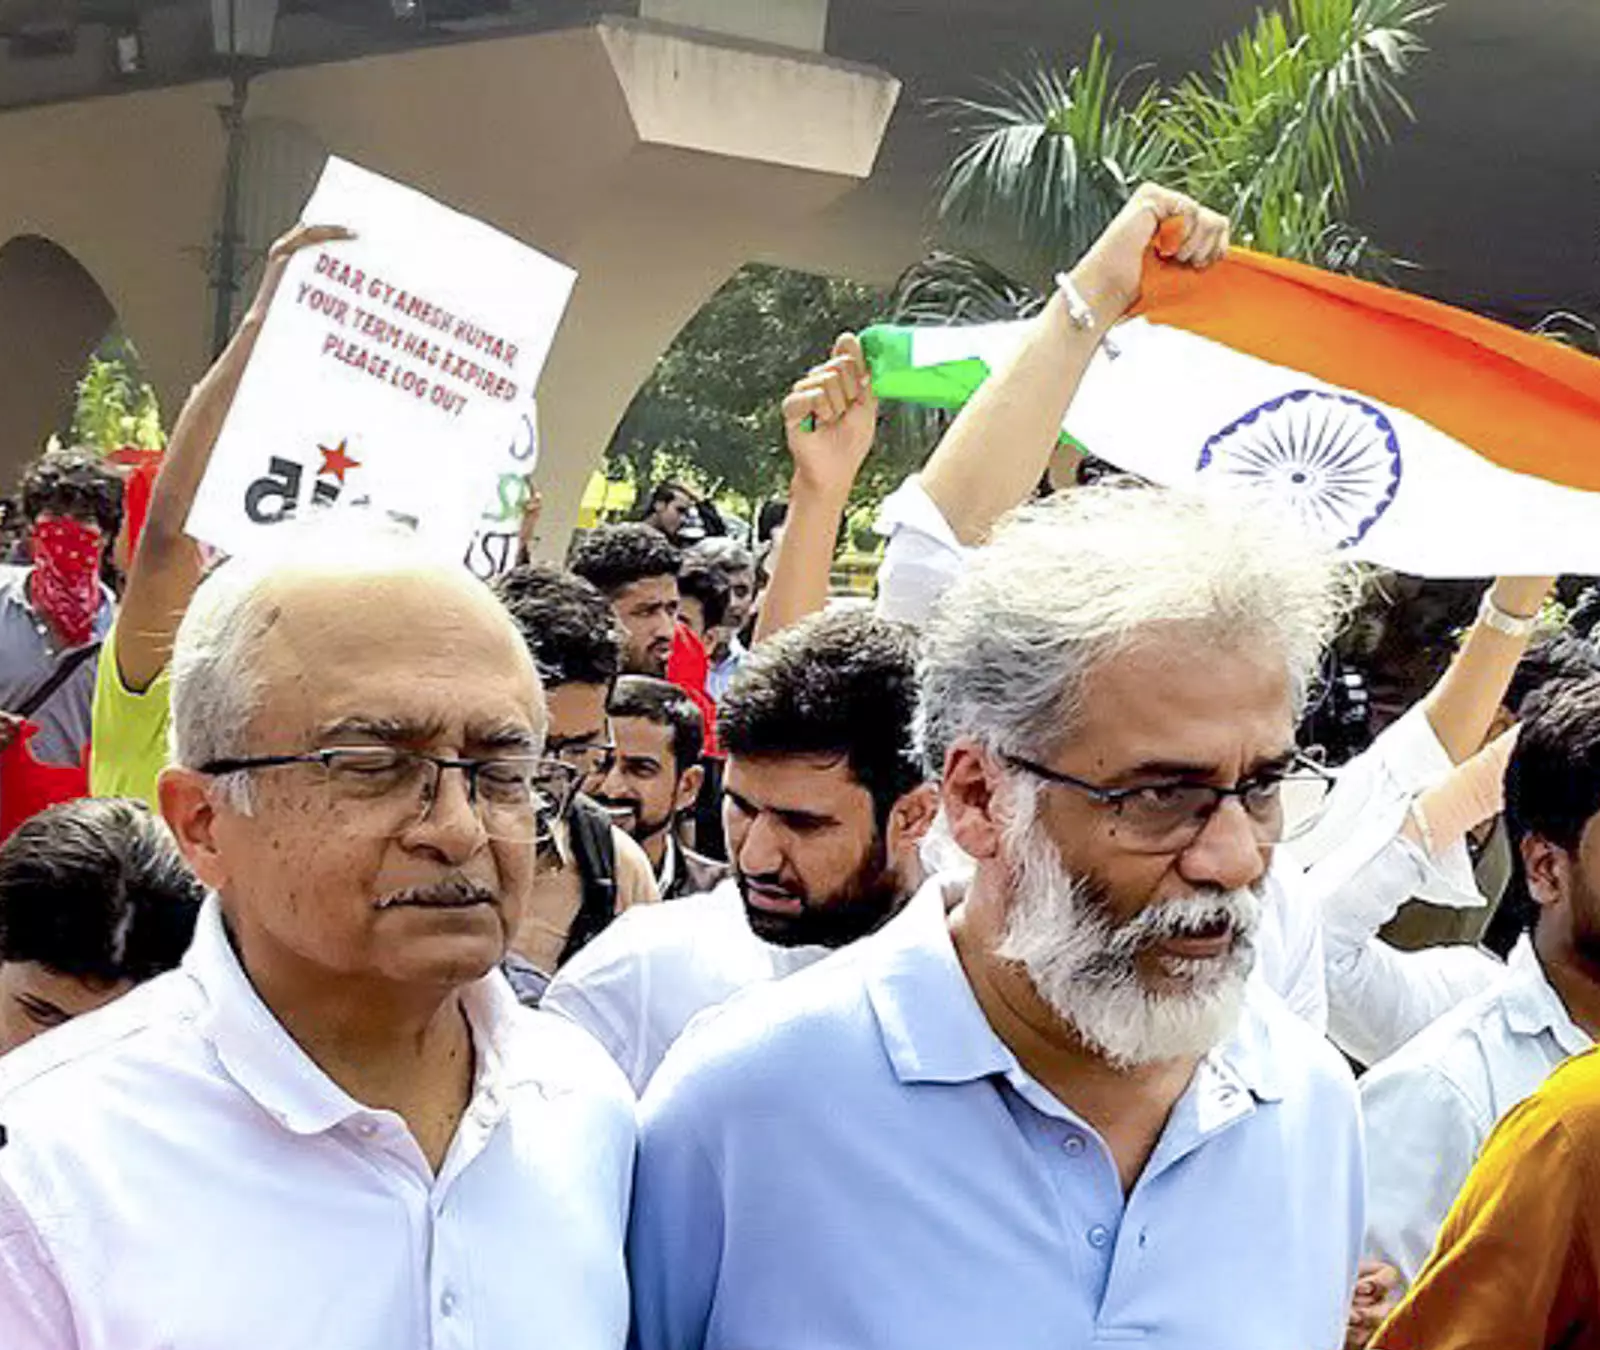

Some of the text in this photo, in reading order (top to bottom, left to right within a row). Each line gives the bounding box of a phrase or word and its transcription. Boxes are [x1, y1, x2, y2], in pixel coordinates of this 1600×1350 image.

[296, 281, 519, 402] YOUR TERM HAS EXPIRED
[315, 253, 366, 294] DEAR
[453, 319, 519, 369] KUMAR
[322, 332, 468, 416] PLEASE LOG OUT
